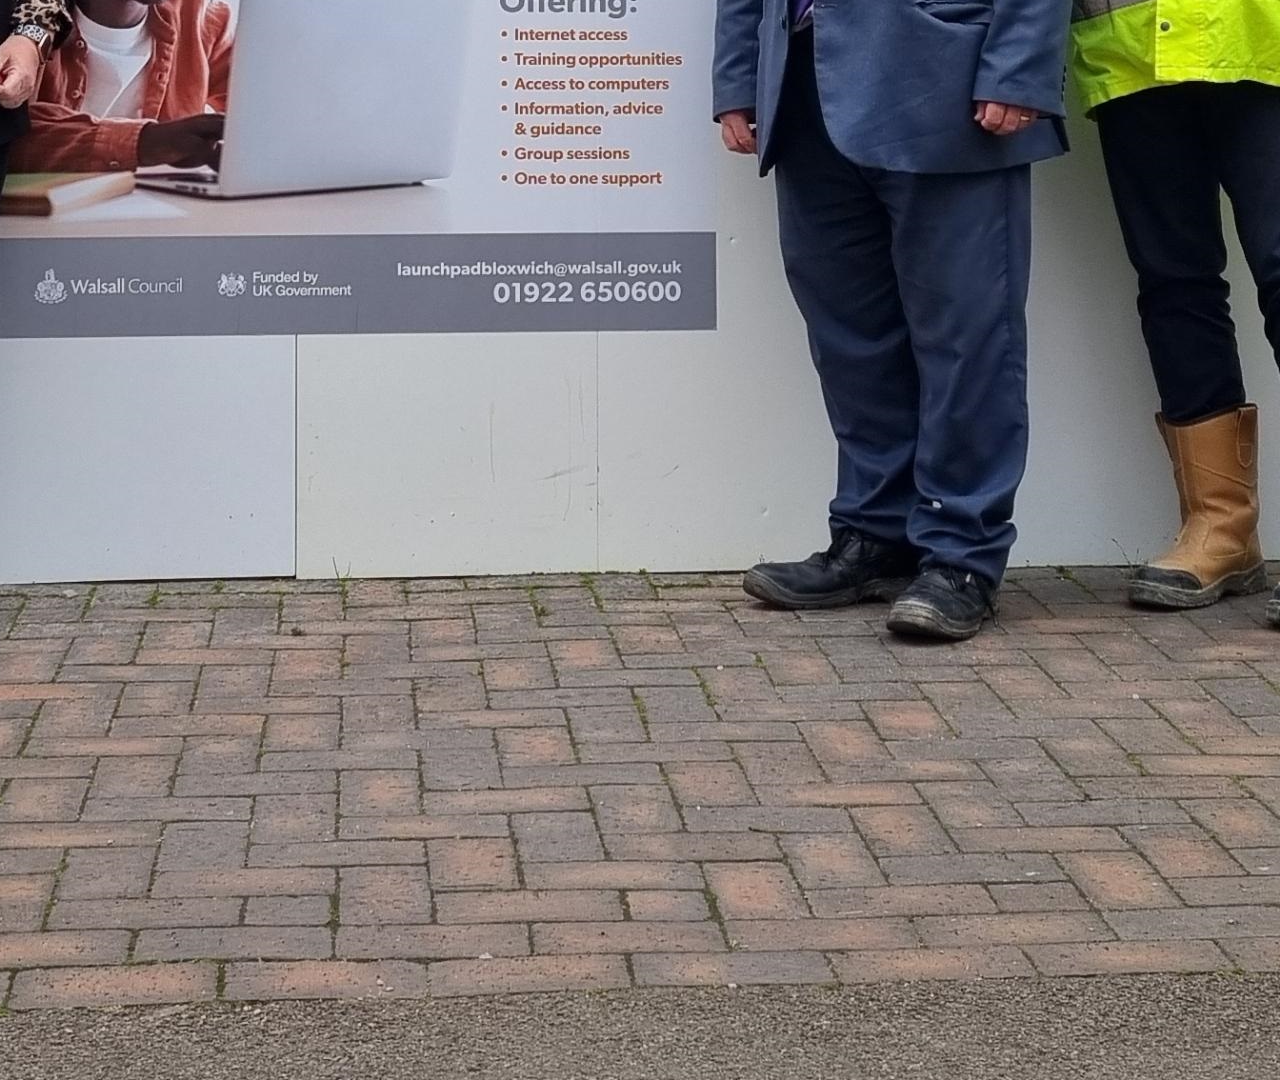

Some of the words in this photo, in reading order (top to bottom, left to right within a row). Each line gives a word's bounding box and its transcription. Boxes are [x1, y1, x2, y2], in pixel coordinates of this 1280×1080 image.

[514, 28, 576, 41] Internet
[578, 29, 628, 41] access
[514, 52, 576, 69] Training
[578, 52, 683, 69] opportunities
[514, 77, 566, 90] Access
[569, 78, 585, 90] to
[588, 77, 670, 93] computers
[514, 102, 609, 117] Information,
[612, 102, 664, 115] advice
[514, 122, 527, 136] &
[530, 122, 602, 138] guidance
[514, 147, 564, 163] Group
[566, 146, 631, 160] sessions
[514, 171, 548, 185] One
[551, 172, 567, 185] to
[569, 173, 599, 185] one
[601, 171, 663, 188] support
[397, 260, 682, 278] launchpadbloxwich@walsall.gov.uk
[70, 277, 125, 294] Walsall
[128, 277, 183, 294] Council
[252, 271, 300, 284] Funded
[303, 271, 319, 286] by
[253, 283, 272, 297] UK
[275, 283, 352, 297] Government
[493, 282, 574, 303] 01922
[580, 281, 682, 303] 650600
